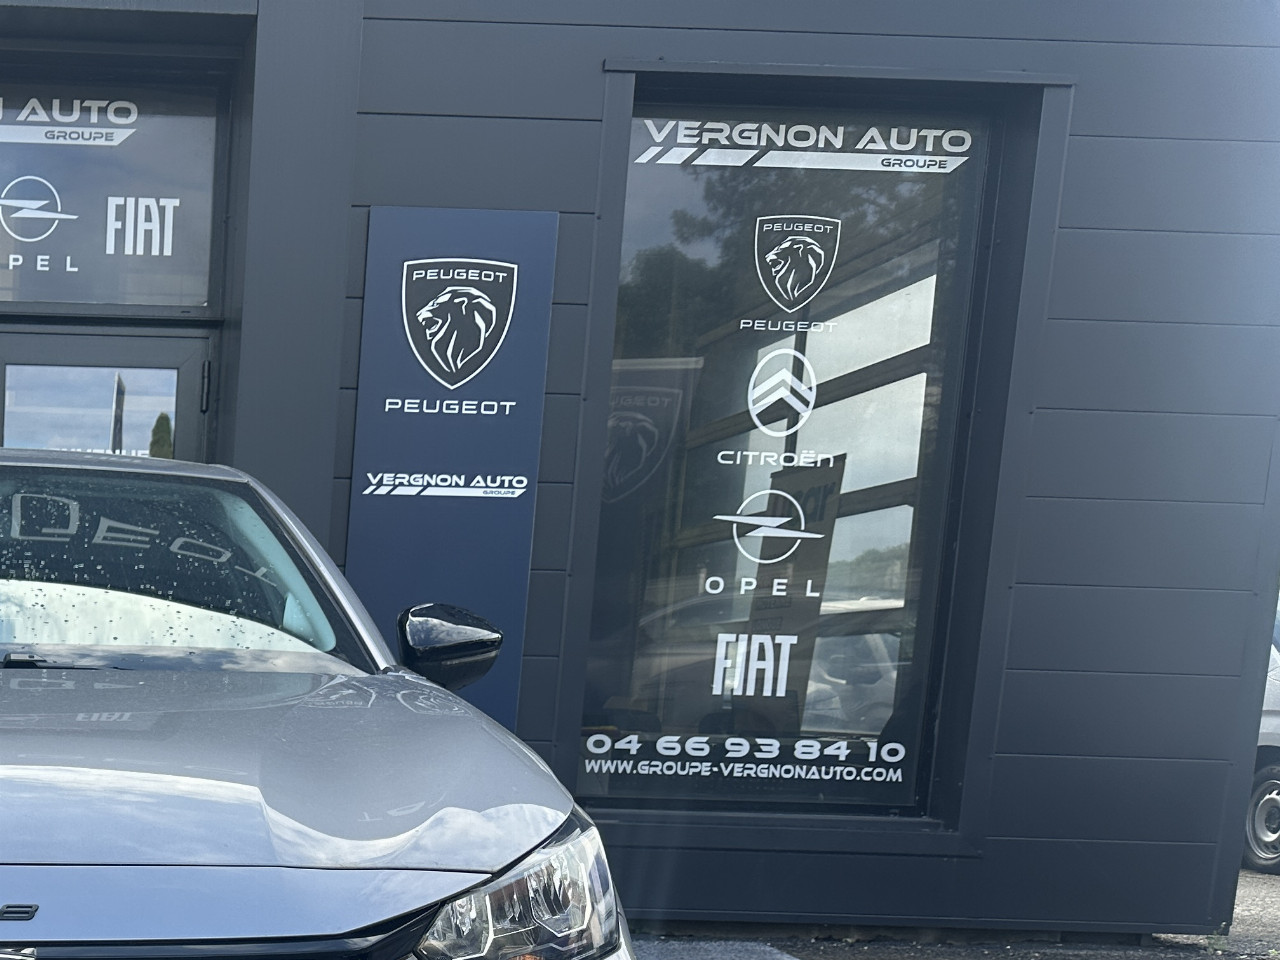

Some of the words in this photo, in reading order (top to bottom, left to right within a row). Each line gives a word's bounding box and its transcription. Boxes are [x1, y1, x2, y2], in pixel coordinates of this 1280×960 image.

[16, 97, 139, 125] AUTO
[44, 129, 116, 142] GROUPE
[644, 119, 844, 149] VERGNON
[855, 127, 972, 153] AUTO
[880, 157, 949, 169] GROUPE
[106, 196, 180, 257] FIAT
[763, 222, 834, 234] PEUGEOT
[412, 268, 508, 283] PEUGEOT
[739, 319, 838, 333] PEUGEOT
[384, 398, 517, 415] PEUGEOT
[367, 472, 463, 486] VERGNON
[470, 475, 528, 488] AUTO
[705, 576, 820, 597] OPEL
[712, 633, 798, 697] FIAT
[586, 733, 642, 755] 04
[655, 735, 711, 757] 66
[724, 737, 781, 759] 93
[793, 739, 852, 761] 84
[867, 741, 906, 763] 10
[584, 759, 903, 783] WWW.GROUPE-VERGNONAUTO.COM
